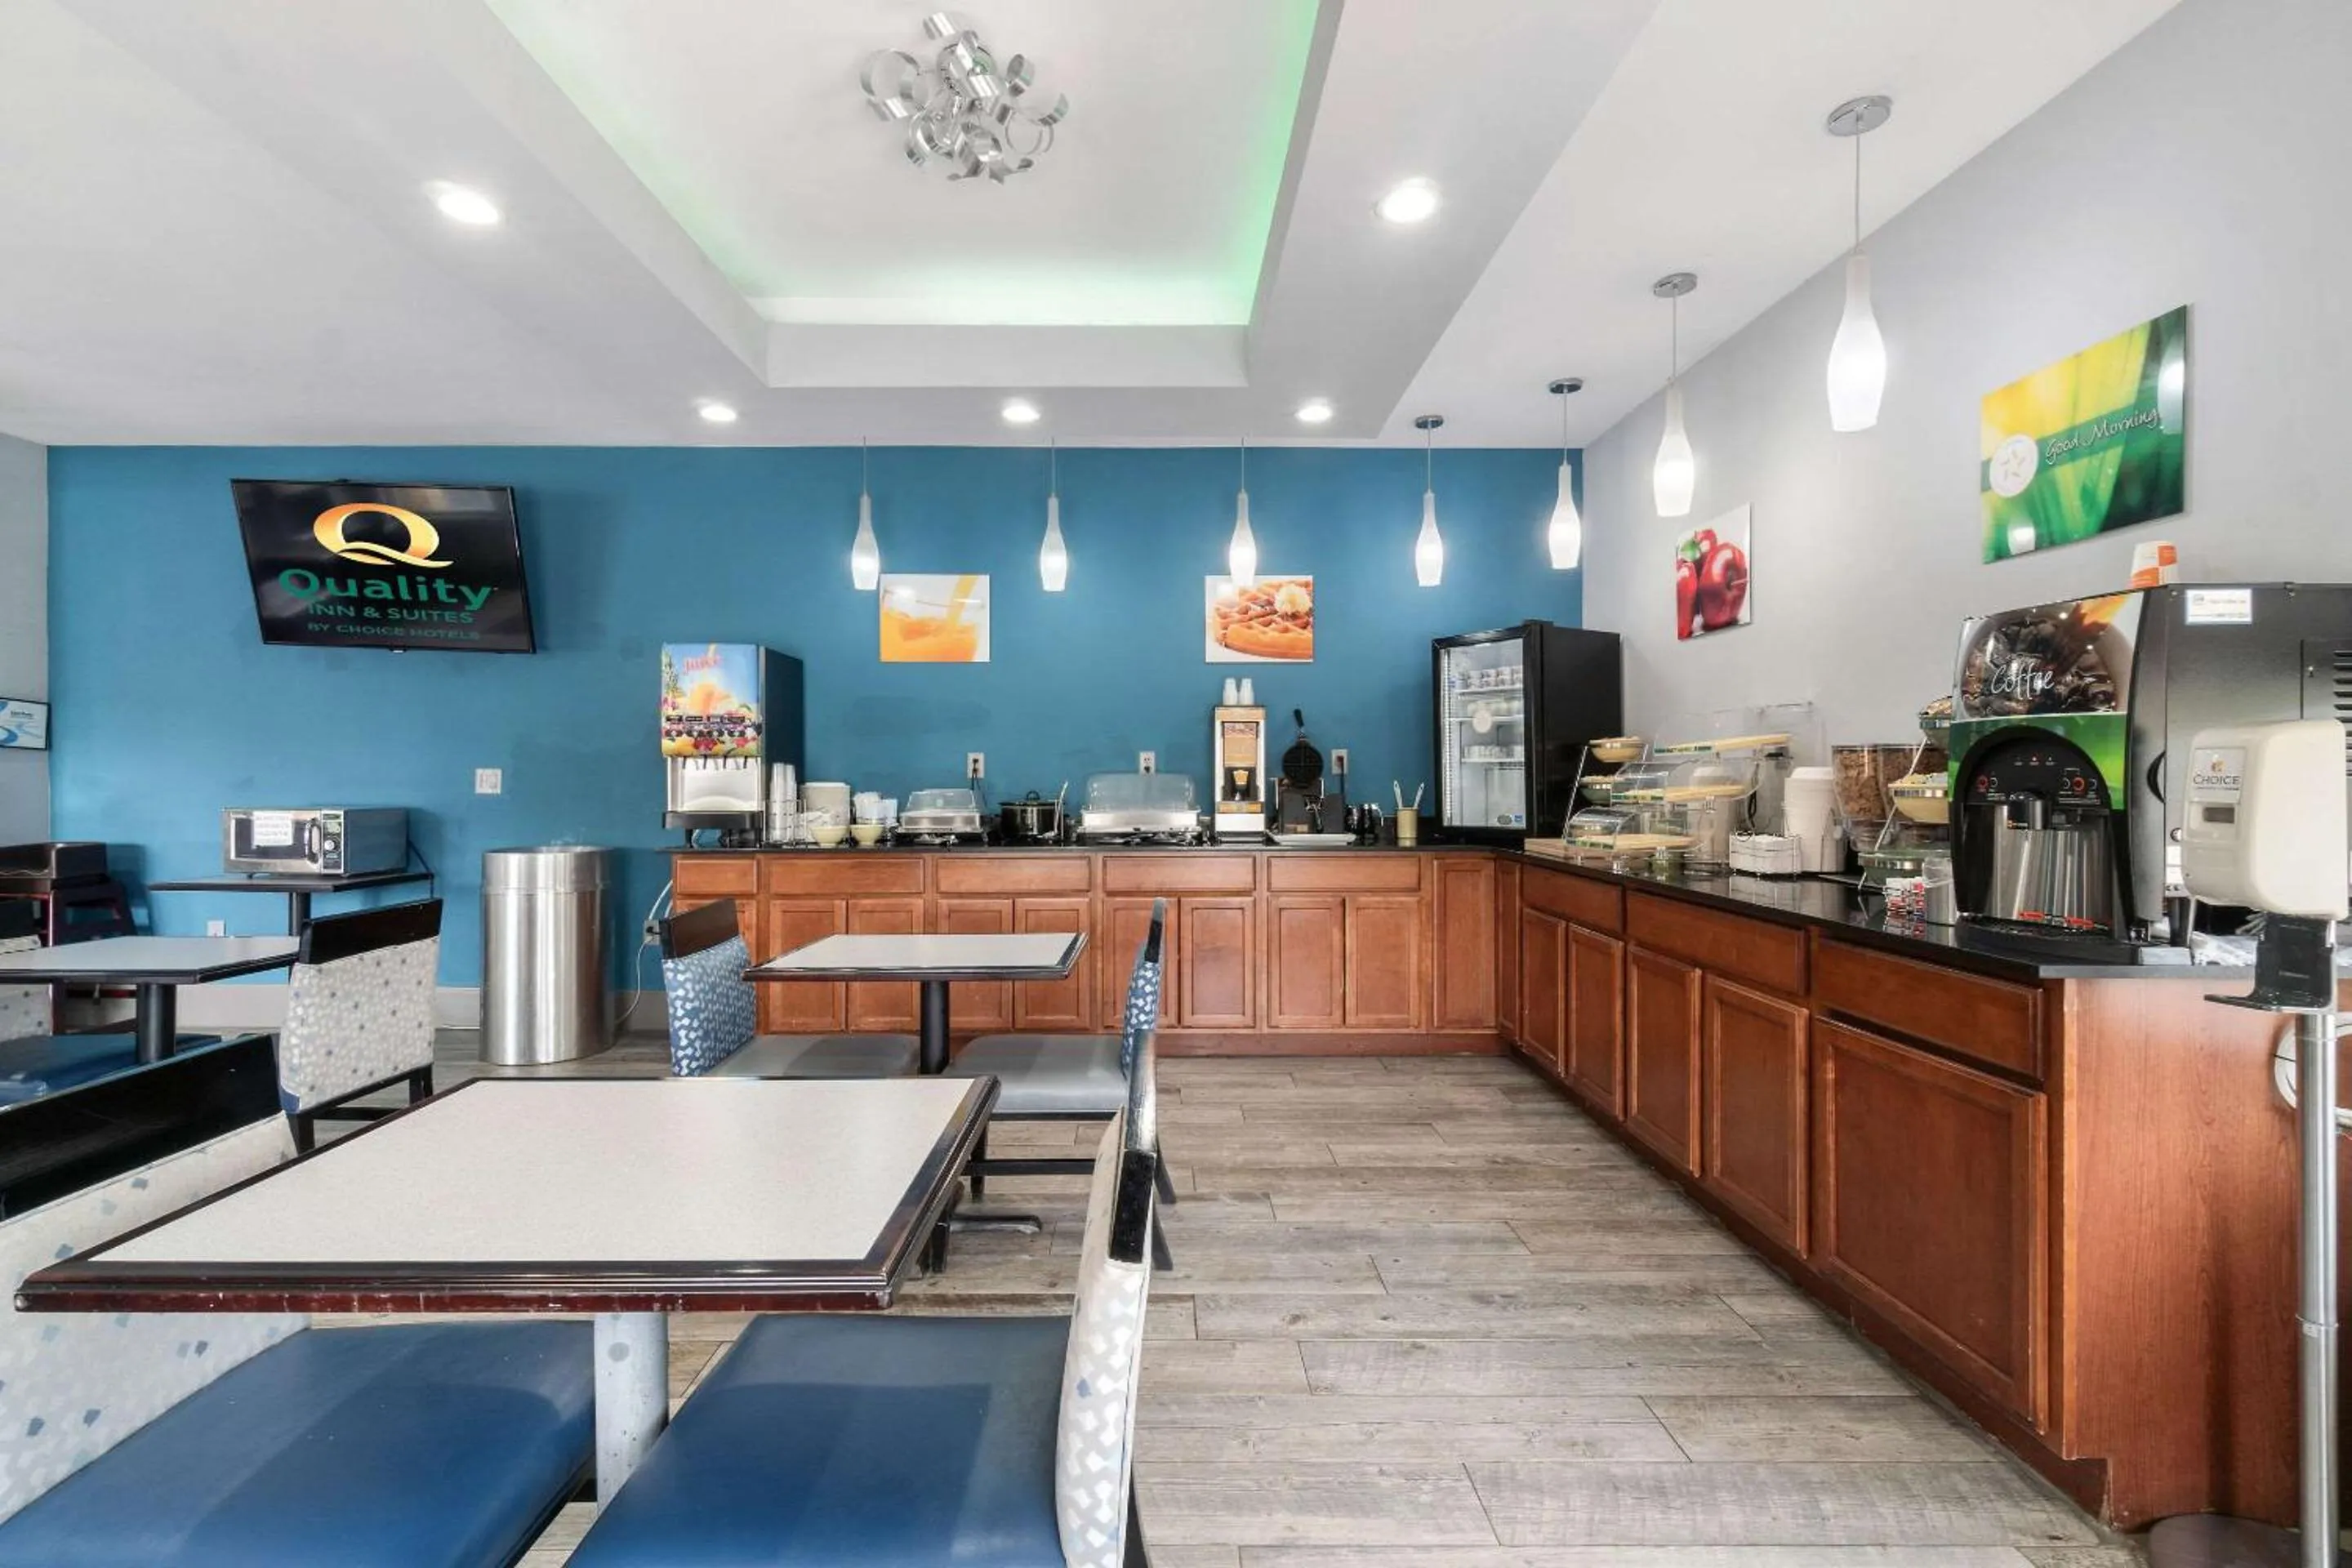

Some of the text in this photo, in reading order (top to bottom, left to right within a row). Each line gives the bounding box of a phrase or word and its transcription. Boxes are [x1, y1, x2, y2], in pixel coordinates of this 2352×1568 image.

[2045, 408, 2158, 465] Good Morning
[278, 569, 491, 610] Quality
[308, 603, 474, 623] INN & SUITES
[308, 623, 480, 640] BY CHOICE HOTELS
[1991, 662, 2055, 700] Coffee
